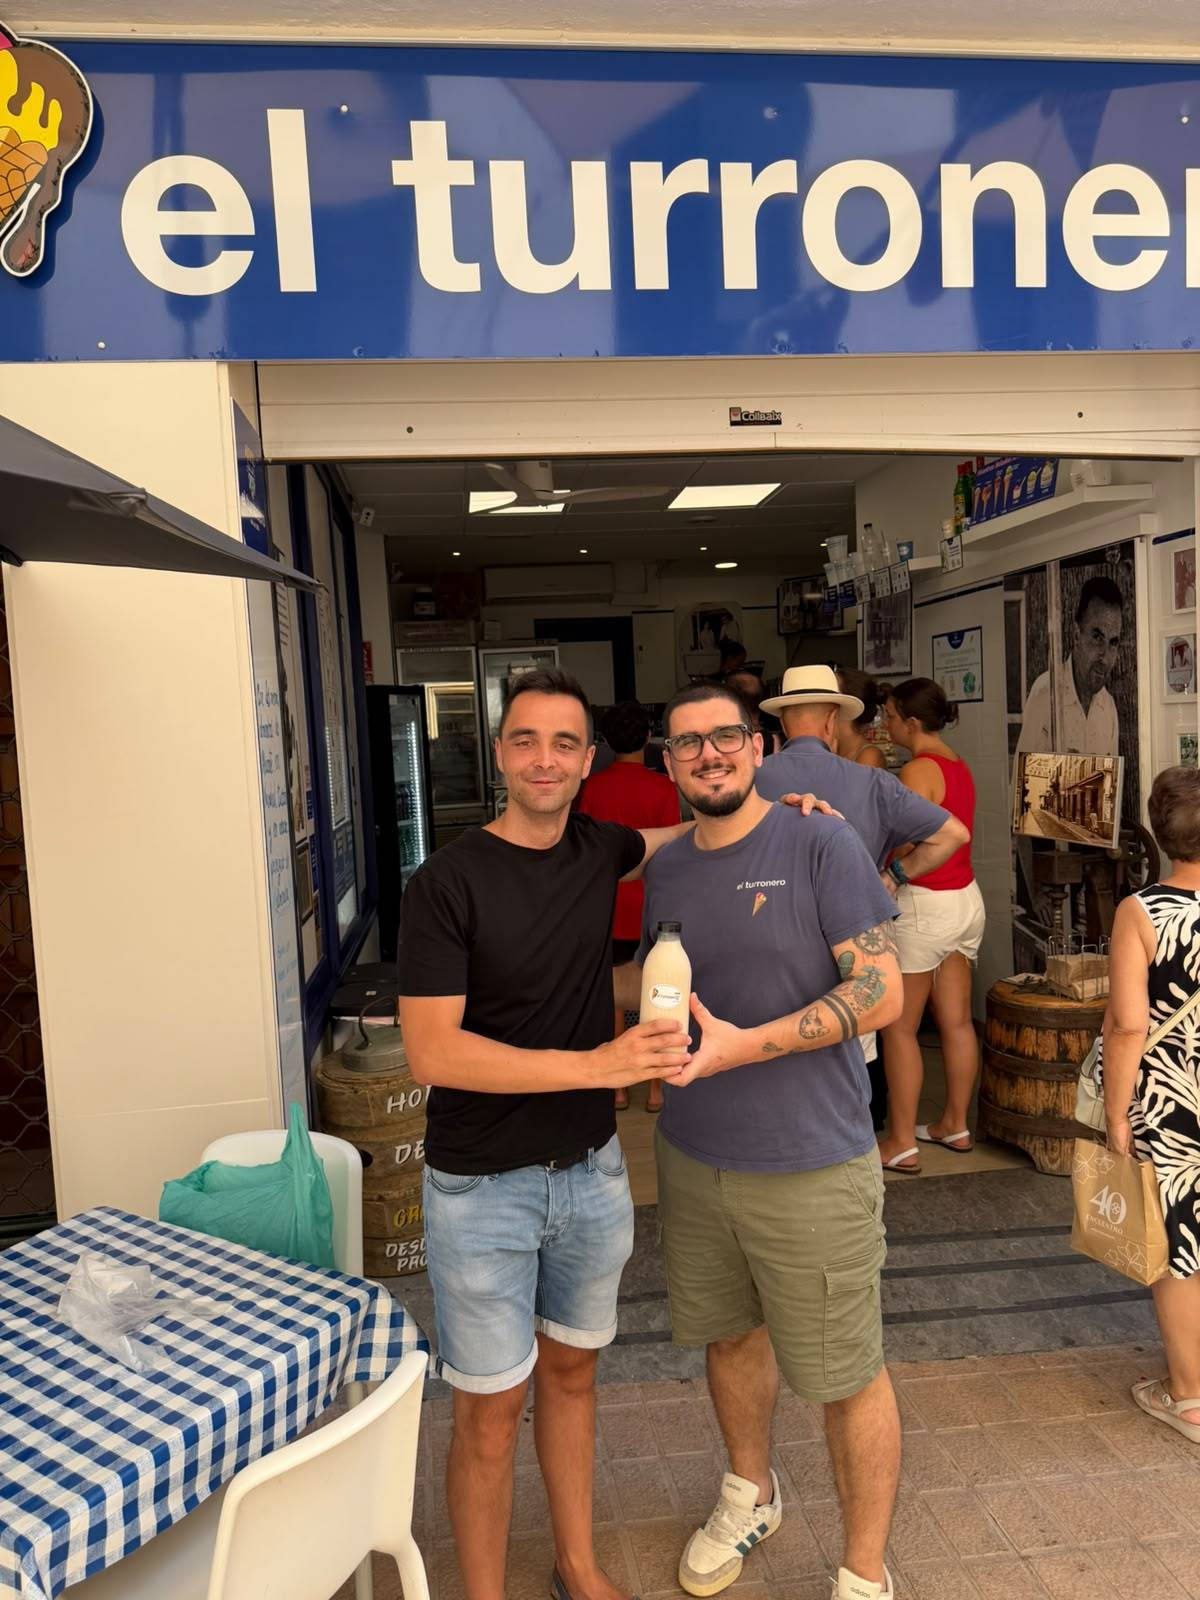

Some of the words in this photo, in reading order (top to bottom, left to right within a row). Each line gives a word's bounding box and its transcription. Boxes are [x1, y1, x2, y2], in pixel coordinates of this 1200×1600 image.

[121, 109, 316, 295] el
[392, 121, 1200, 293] turrone
[736, 882, 744, 890] el
[745, 879, 786, 889] turronero
[1089, 1185, 1127, 1225] 40
